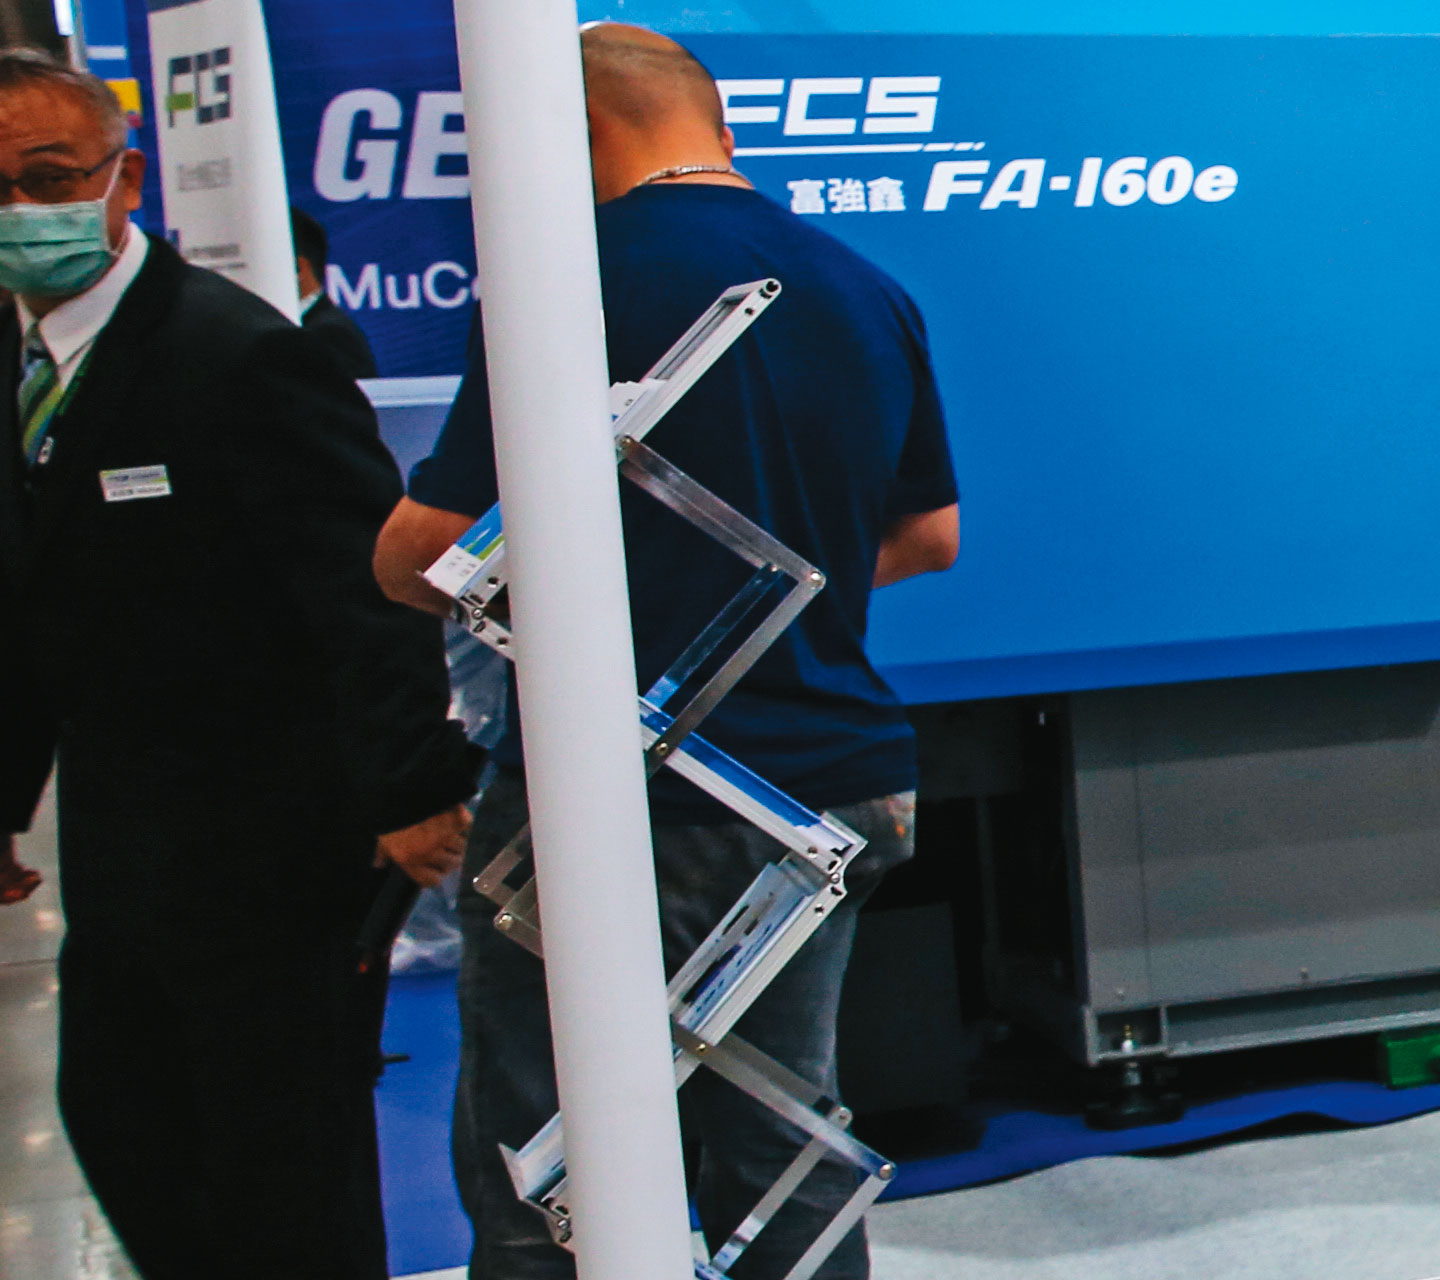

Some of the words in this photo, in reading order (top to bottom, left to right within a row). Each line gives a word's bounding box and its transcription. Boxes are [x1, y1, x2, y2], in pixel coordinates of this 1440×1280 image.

[715, 75, 942, 137] FCS
[786, 176, 907, 215] 富強鑫
[922, 155, 1239, 212] FA-160e
[325, 261, 480, 311] MuC
